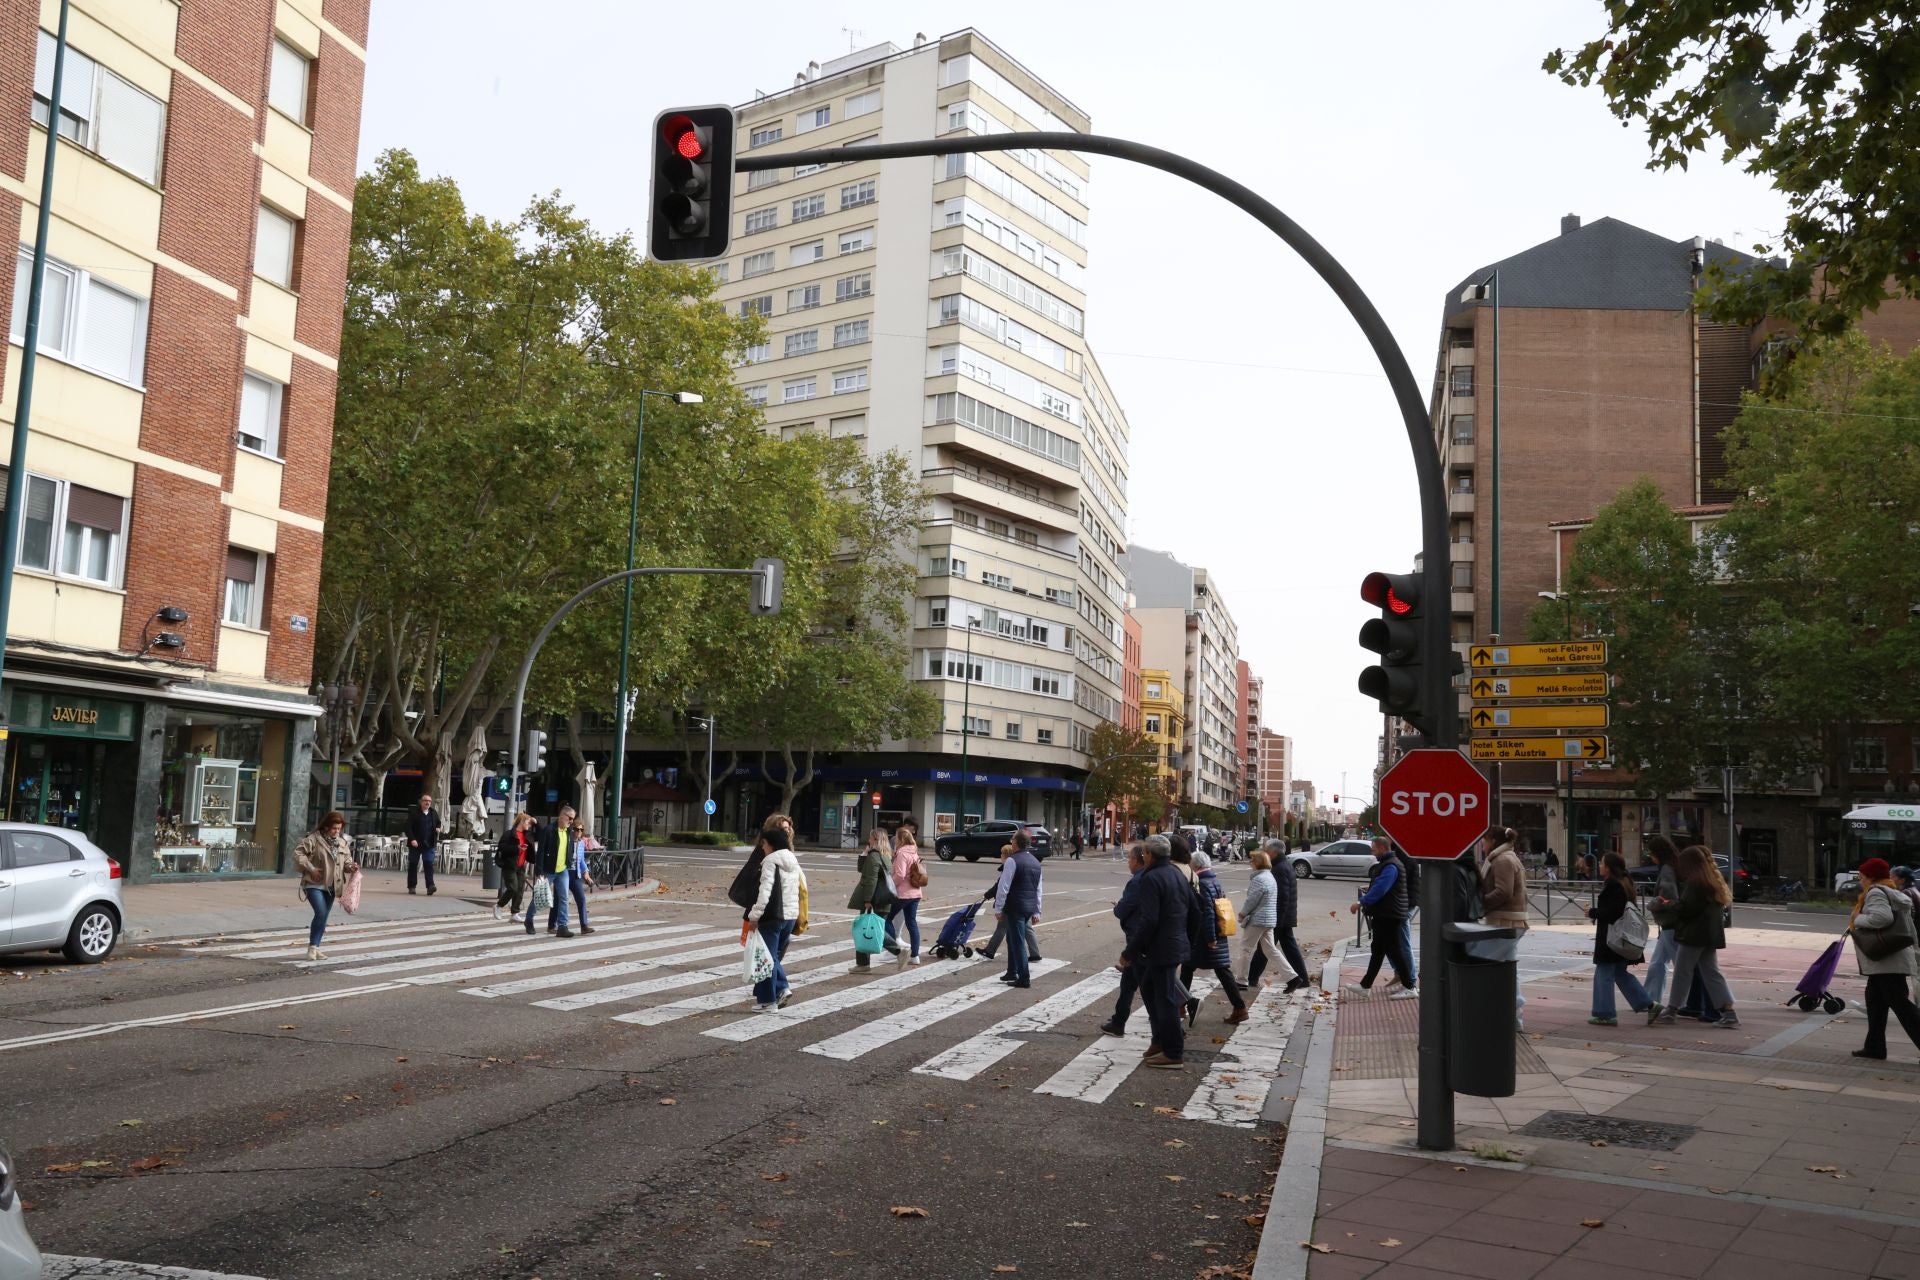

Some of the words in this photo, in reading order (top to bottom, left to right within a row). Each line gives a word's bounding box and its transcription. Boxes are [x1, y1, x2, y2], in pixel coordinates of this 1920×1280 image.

[1560, 645, 1588, 653] Felipe
[1569, 653, 1602, 661] Gareus
[52, 706, 98, 724] JAVIER
[1496, 740, 1525, 748] Silken
[1514, 749, 1547, 757] Austria
[936, 771, 951, 779] BBVA
[975, 774, 988, 782] BBVA
[1390, 790, 1478, 817] STOP
[1887, 809, 1915, 817] eco
